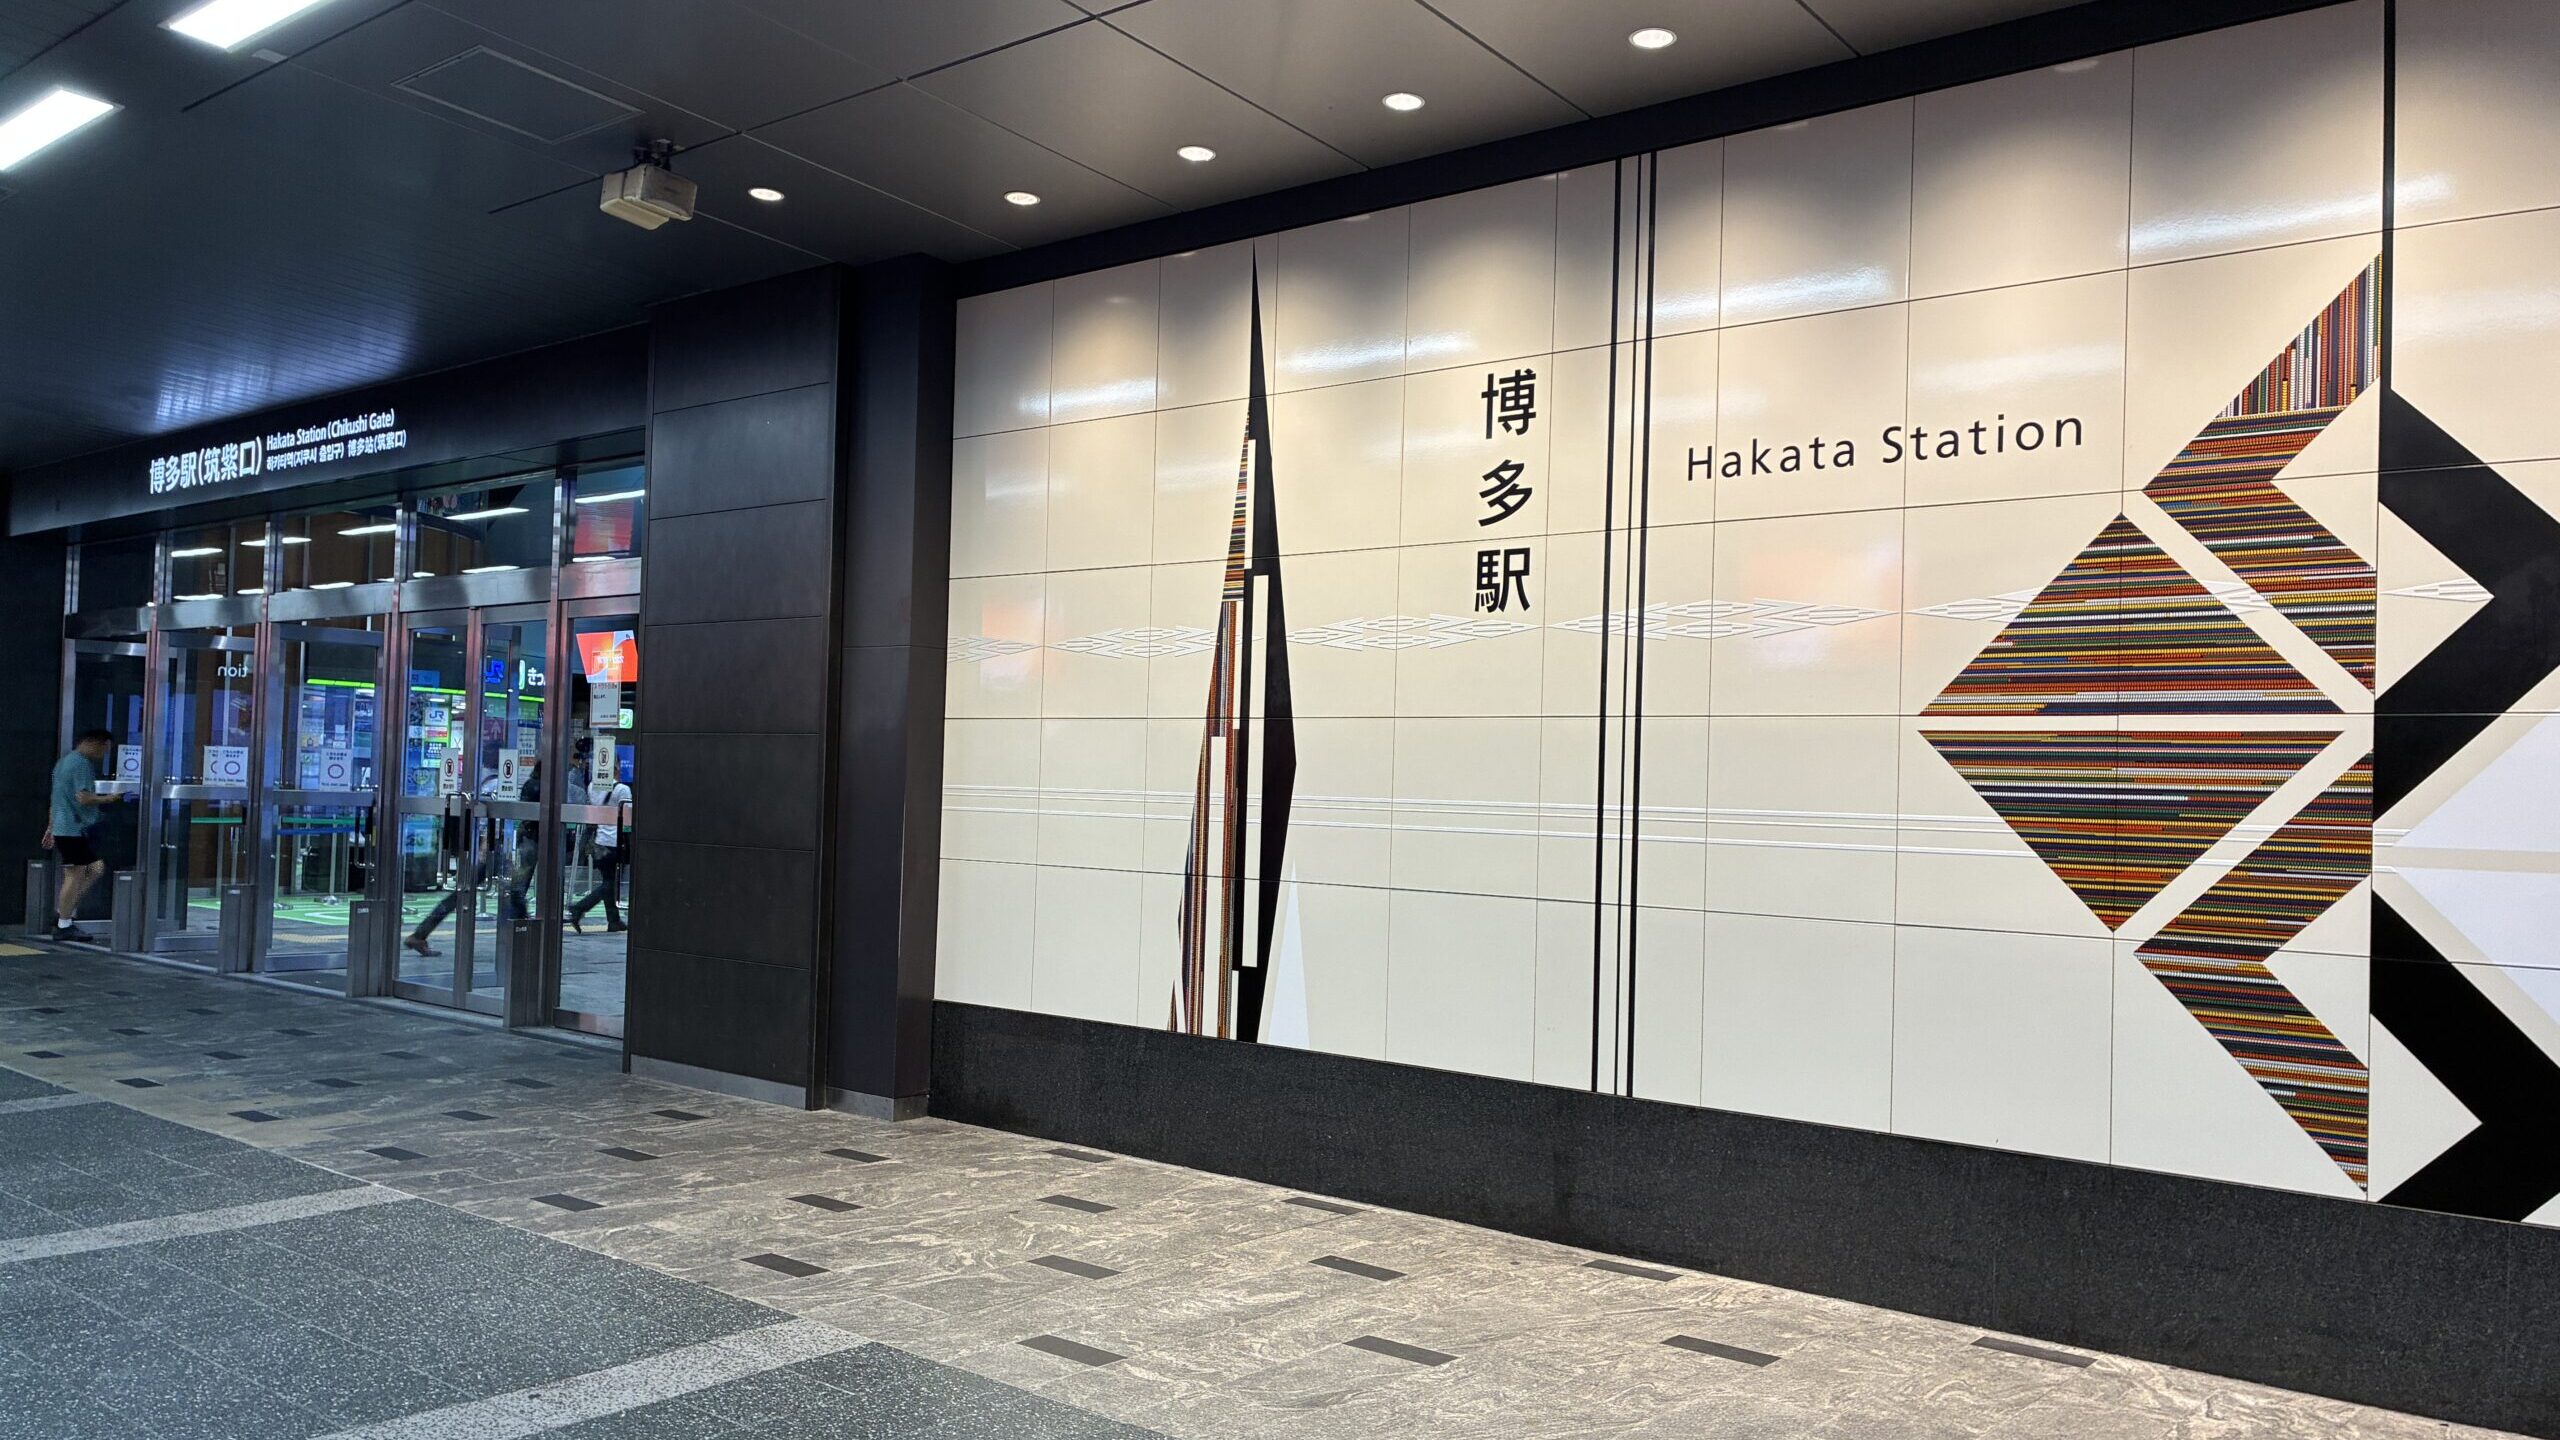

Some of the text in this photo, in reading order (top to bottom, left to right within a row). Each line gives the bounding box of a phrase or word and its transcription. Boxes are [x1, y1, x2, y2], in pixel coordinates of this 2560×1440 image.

[266, 408, 395, 451] Hakata Station (Chikushi Gate)
[1687, 413, 2084, 482] Hakata Station
[149, 435, 262, 495] 博多駅(筑紫口)
[1474, 369, 1537, 613] 博多駅
[527, 666, 546, 686] きっ
[429, 710, 445, 720] JR
